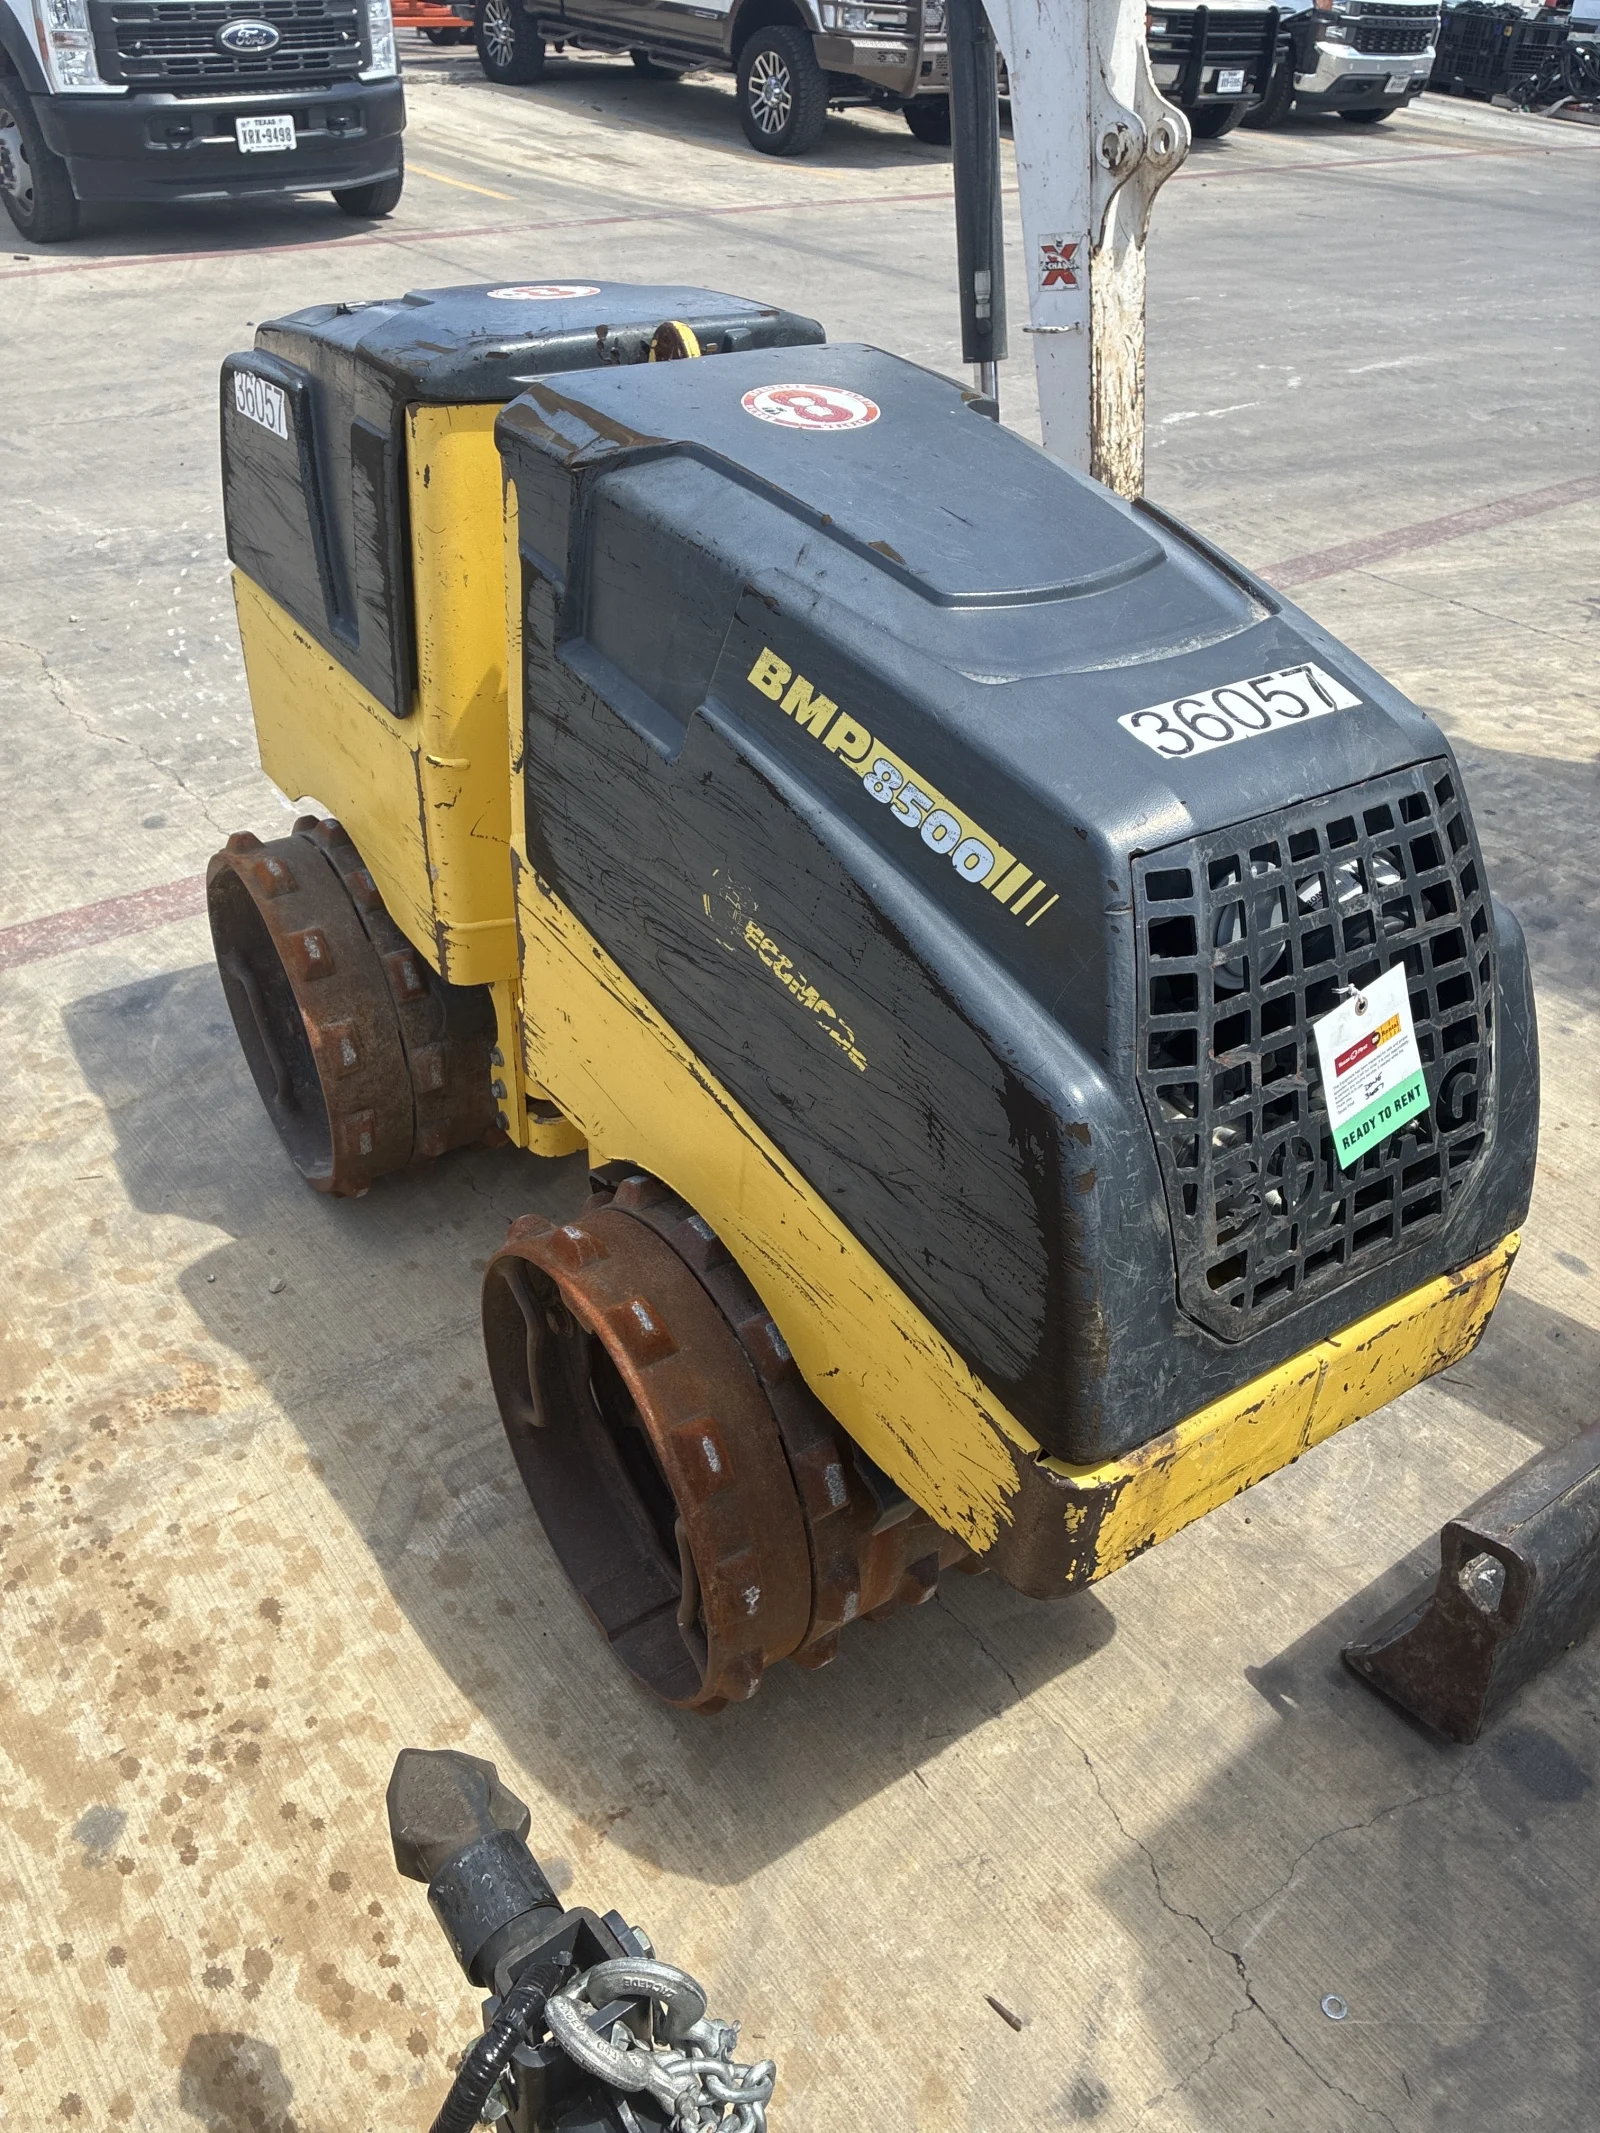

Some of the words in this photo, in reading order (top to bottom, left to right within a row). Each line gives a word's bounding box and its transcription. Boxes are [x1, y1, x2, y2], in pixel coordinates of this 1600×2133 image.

[235, 29, 268, 46] Ford
[254, 118, 277, 127] TEXAS
[235, 371, 283, 434] 36057
[1130, 665, 1338, 756] 36057
[1381, 1020, 1400, 1037] Rental
[1357, 1043, 1369, 1055] First
[1342, 1117, 1377, 1151] READY
[1377, 1105, 1393, 1124] TO
[1393, 1083, 1422, 1114] RENT
[622, 1975, 679, 1999] LACLEDE
